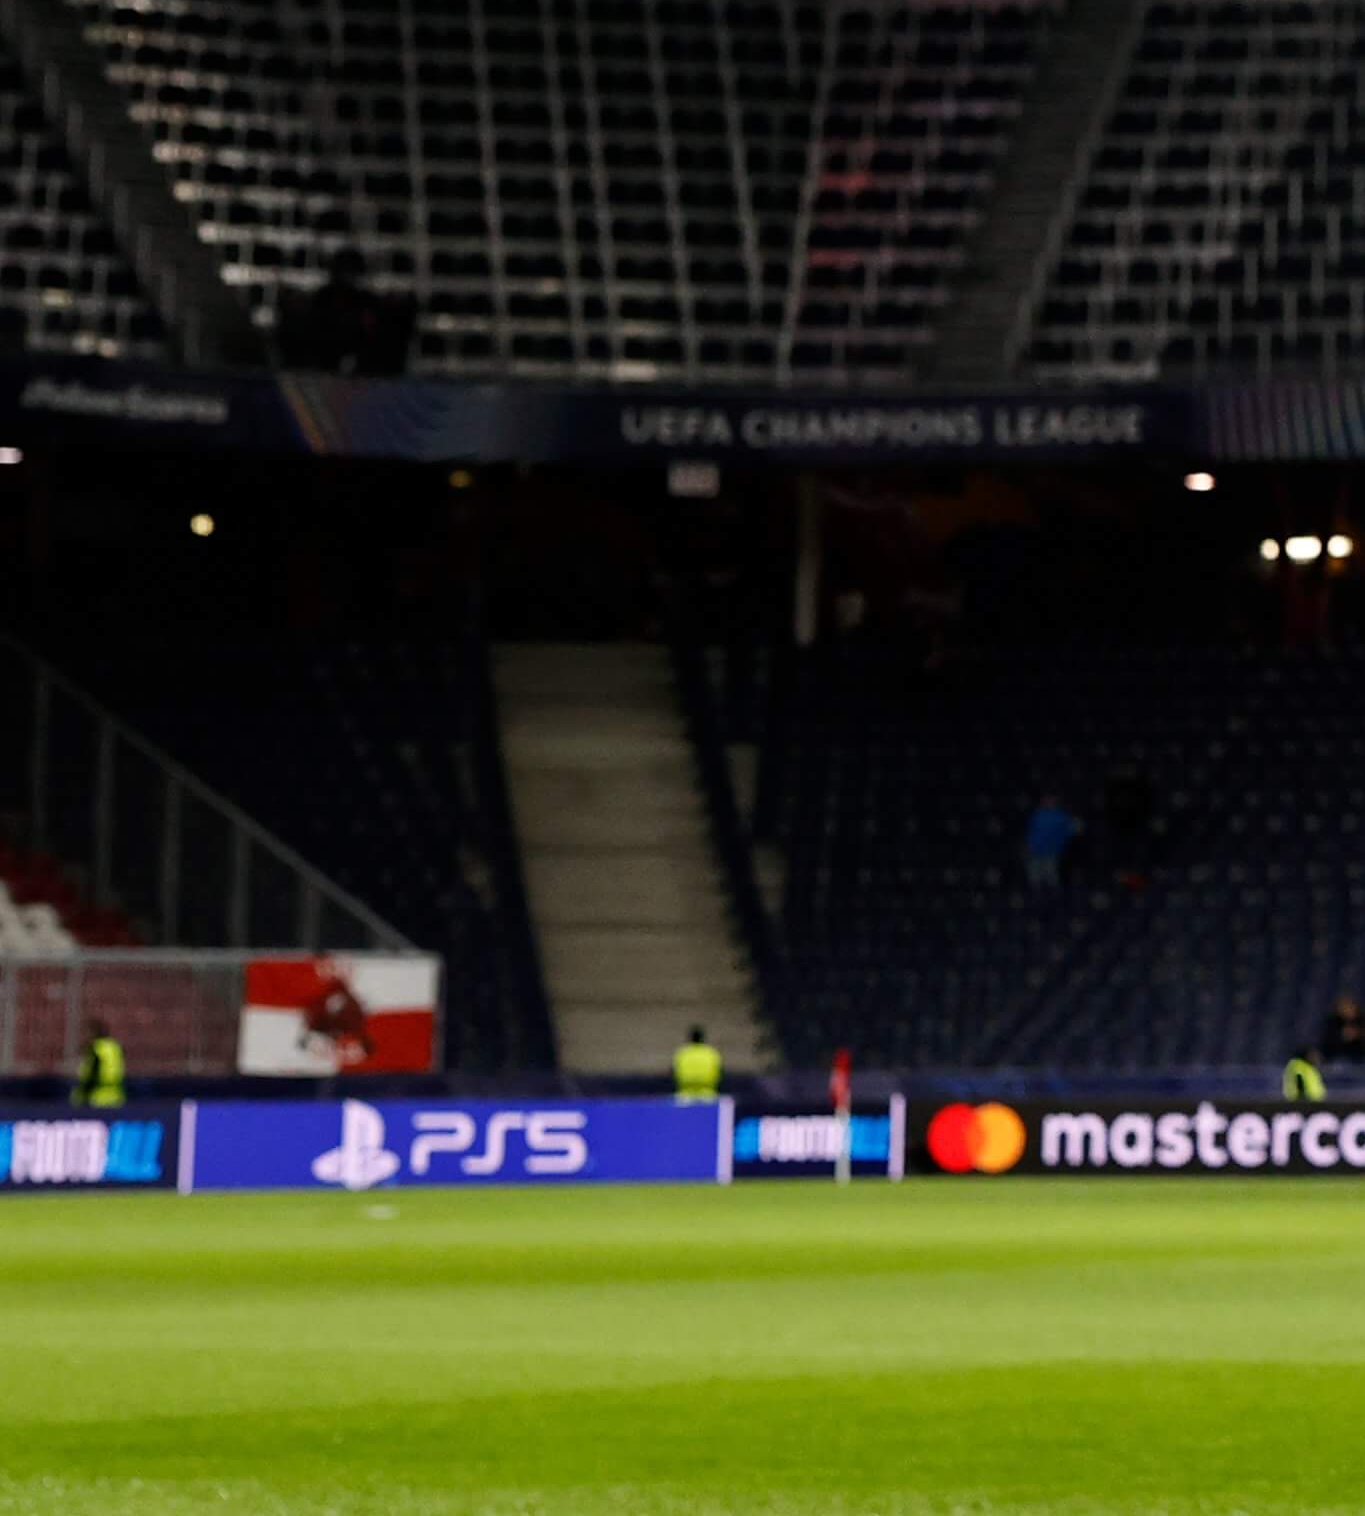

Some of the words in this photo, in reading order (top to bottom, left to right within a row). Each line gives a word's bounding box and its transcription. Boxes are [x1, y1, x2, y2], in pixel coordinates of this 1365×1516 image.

[619, 406, 734, 446] UEFA
[740, 405, 983, 449] CHAMPIONS
[993, 404, 1144, 445] LEAGUE
[409, 1110, 590, 1176] PS5
